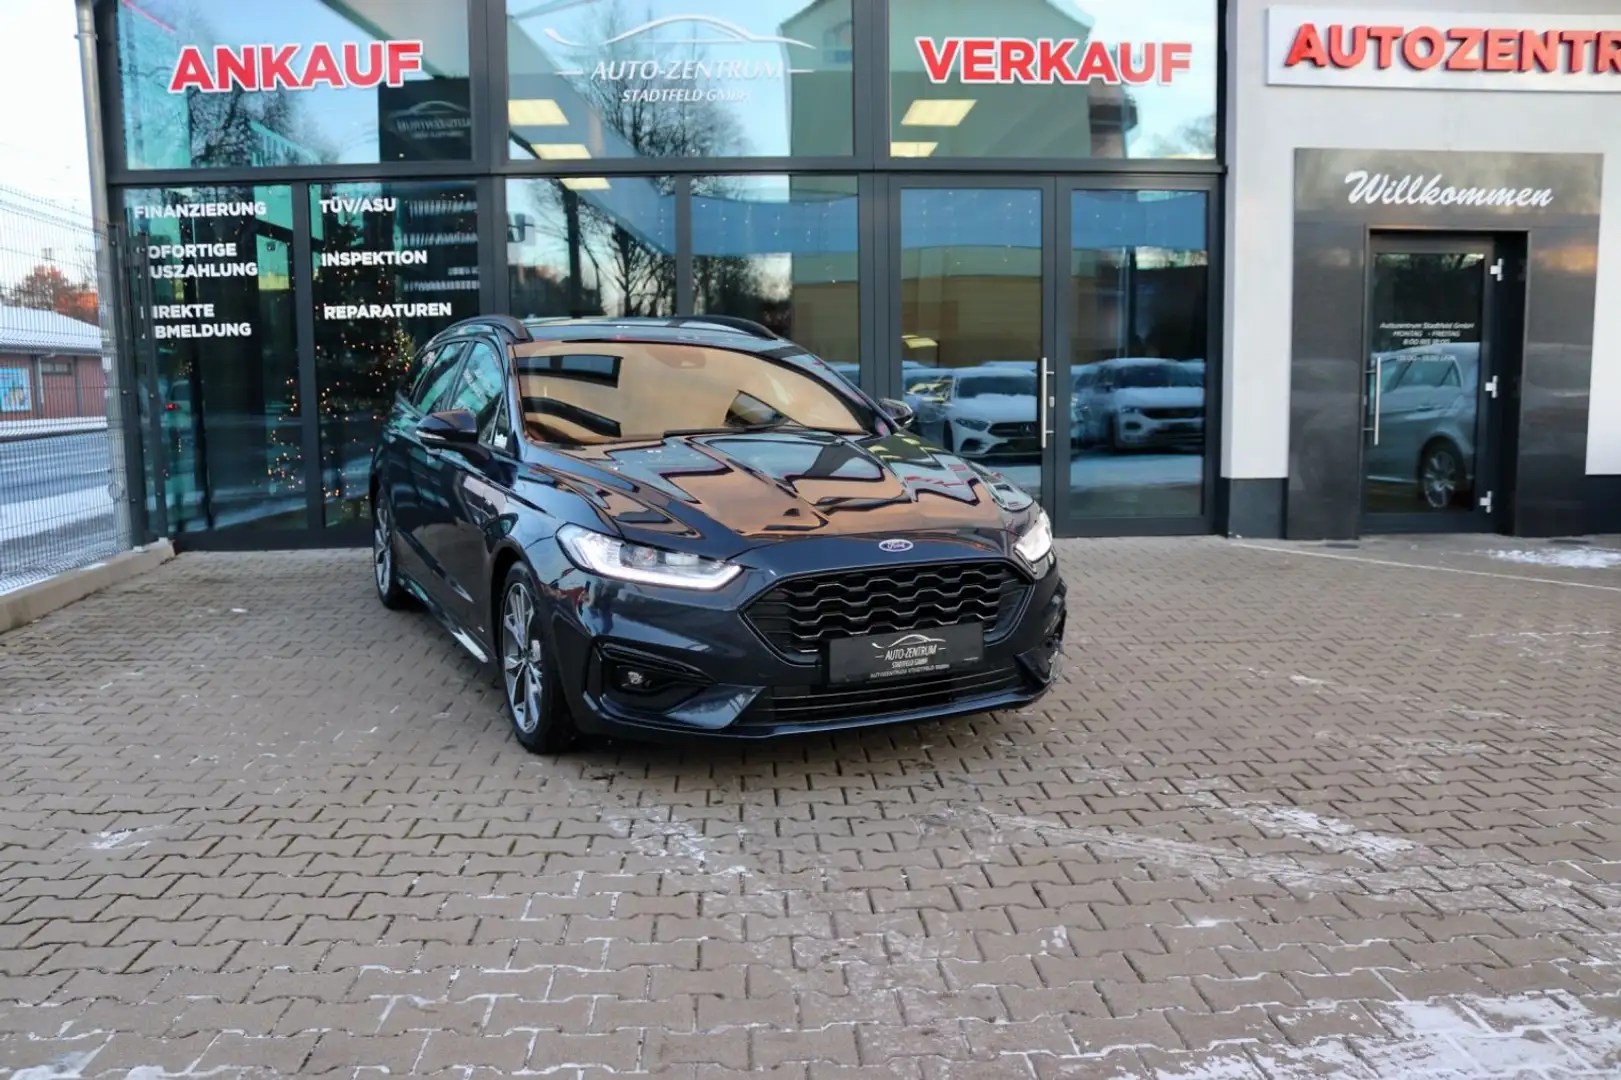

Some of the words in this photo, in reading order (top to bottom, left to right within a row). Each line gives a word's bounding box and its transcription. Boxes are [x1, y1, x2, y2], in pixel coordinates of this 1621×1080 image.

[1284, 23, 1621, 73] AUTOZENTR
[168, 41, 423, 94] ANKAUF
[915, 36, 1193, 86] VERKAUF
[590, 60, 783, 81] AUTO-ZENTRUM
[621, 88, 701, 103] STADTFELD
[1344, 170, 1553, 208] Willkommen
[134, 202, 267, 219] FINANZIERUNG
[319, 196, 397, 214] TÜV/ASU
[136, 243, 237, 259] OFORTIGE
[321, 250, 428, 267] INSPEKTION
[138, 262, 258, 279] USZAHLUNG
[140, 304, 215, 319] IREKTE
[324, 302, 452, 320] REPARATUREN
[142, 323, 252, 339] BMELDUNG
[885, 644, 938, 660] AUTO-ZENTRUM
